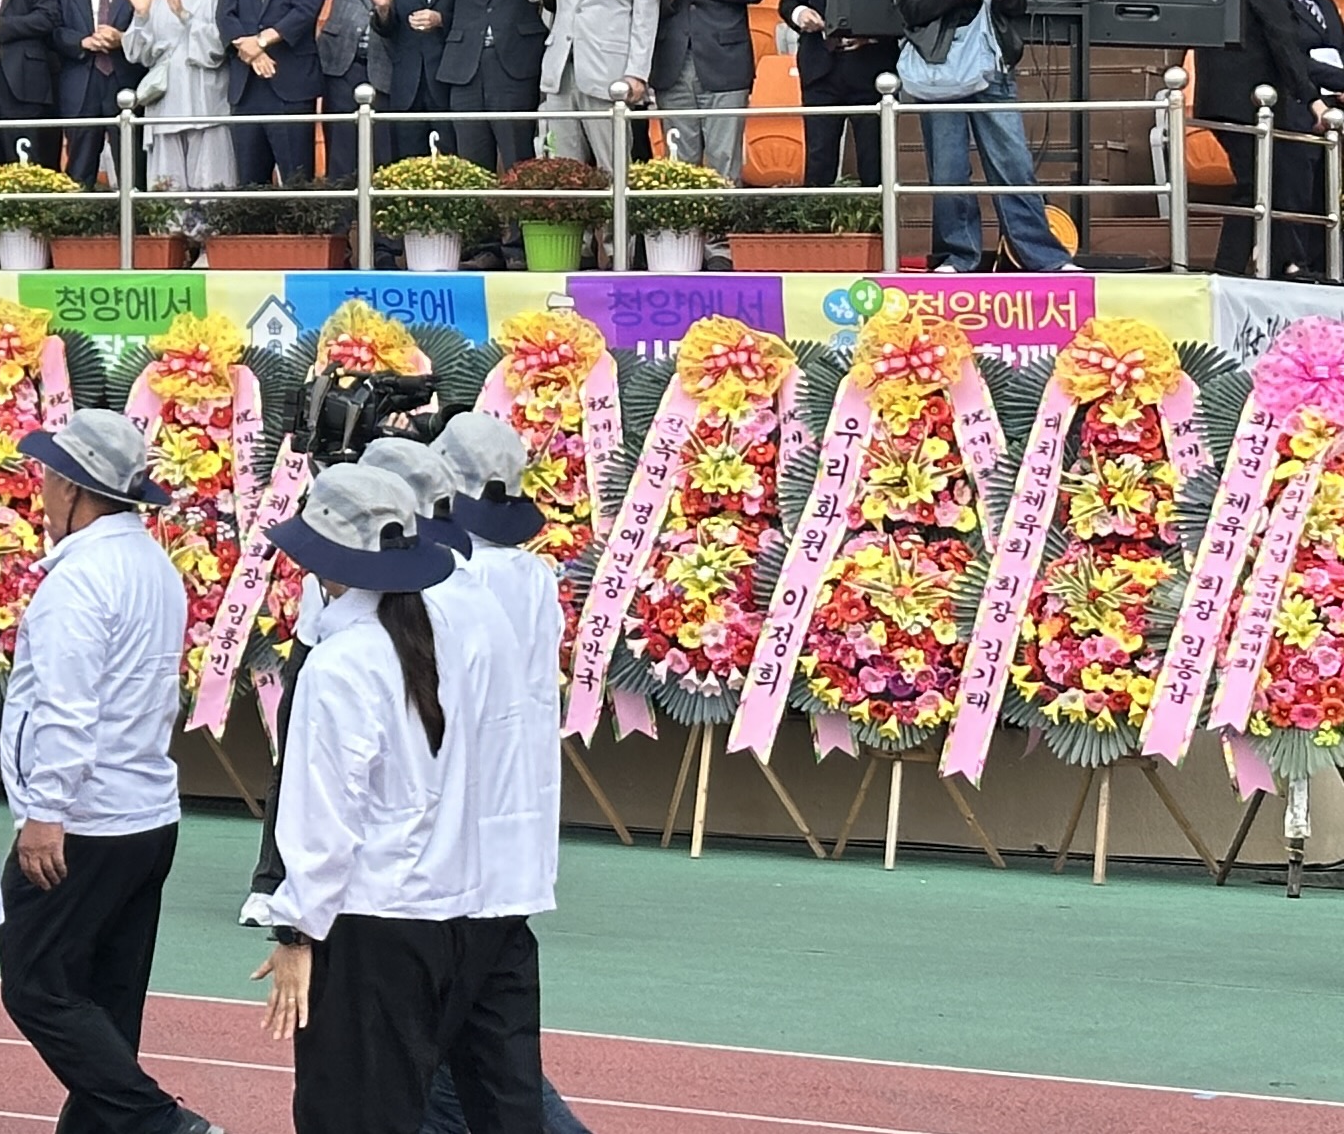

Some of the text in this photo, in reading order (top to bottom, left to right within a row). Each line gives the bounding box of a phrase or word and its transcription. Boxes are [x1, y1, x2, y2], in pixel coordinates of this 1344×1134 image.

[54, 286, 192, 322] 청양에서
[606, 288, 766, 329] 청양에서
[908, 290, 1078, 331] 청양에서
[753, 417, 863, 696] 우리화원 이정희
